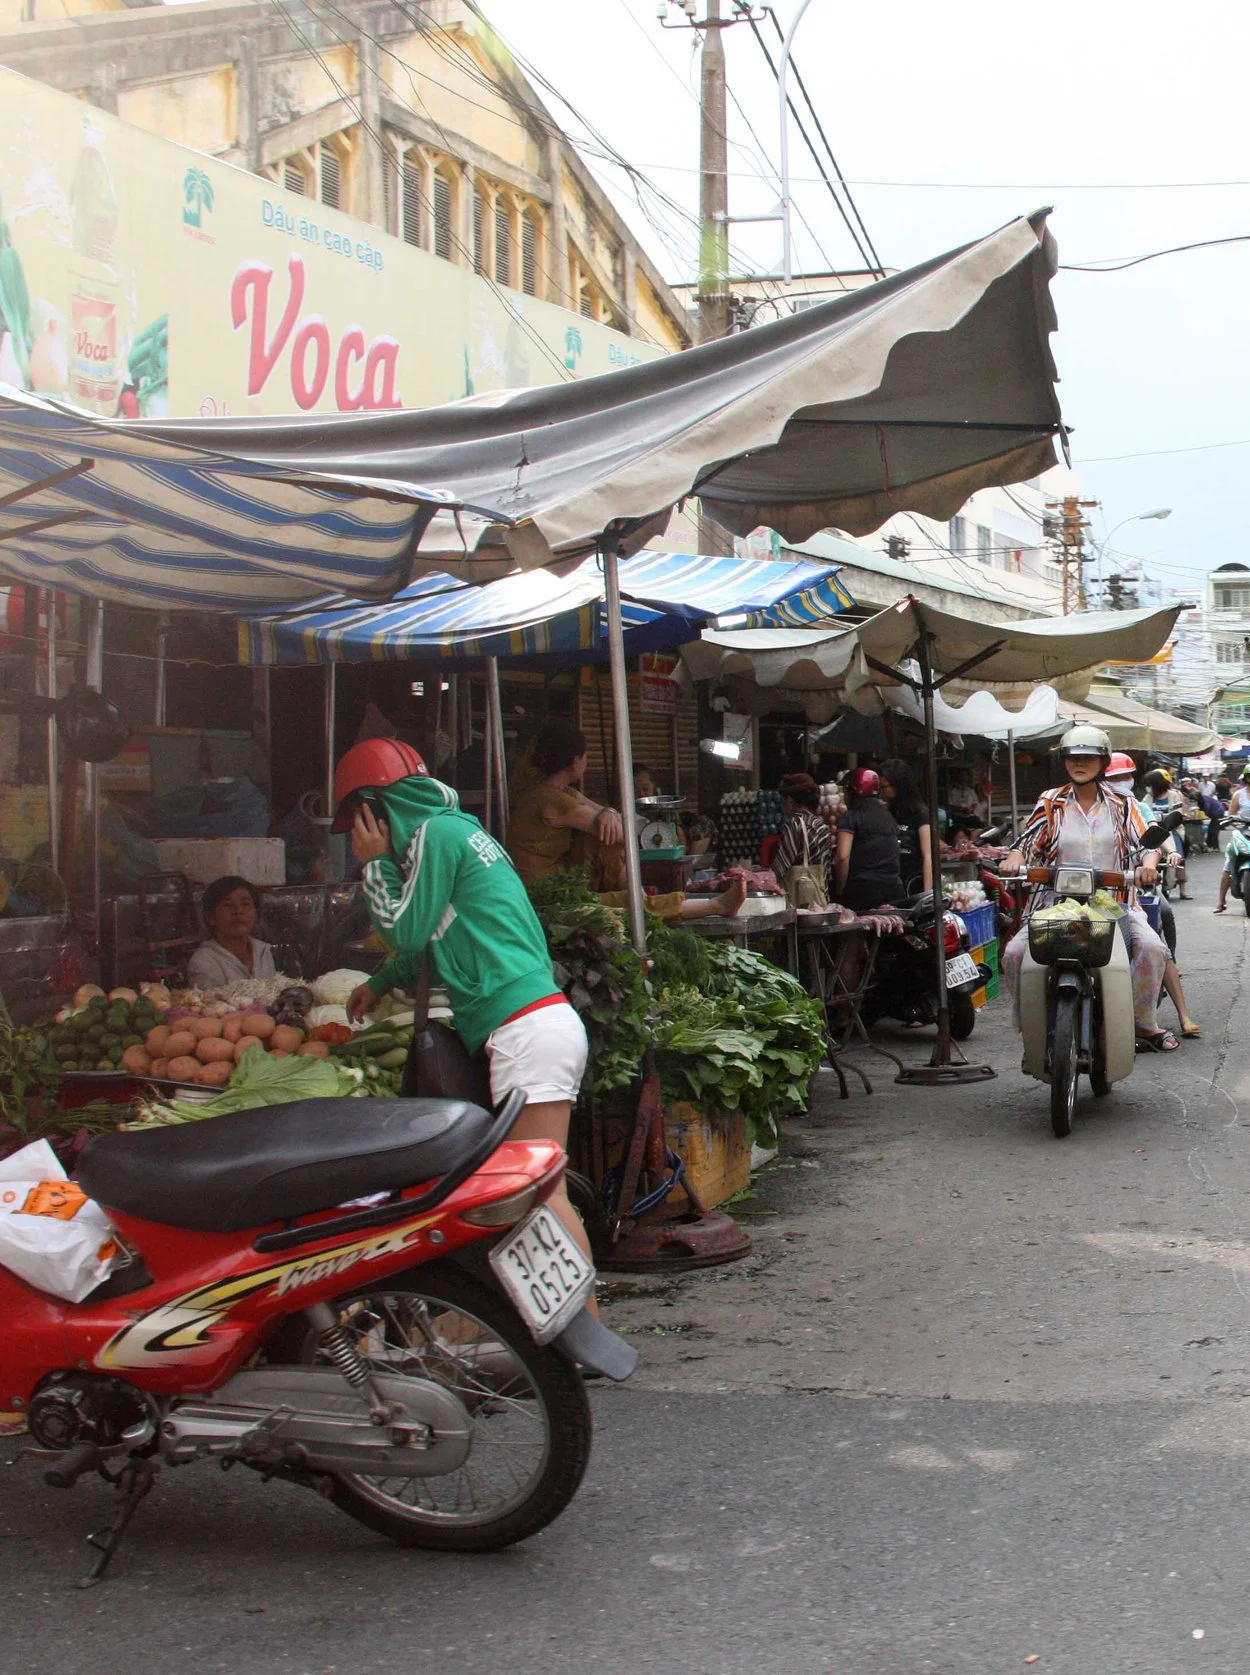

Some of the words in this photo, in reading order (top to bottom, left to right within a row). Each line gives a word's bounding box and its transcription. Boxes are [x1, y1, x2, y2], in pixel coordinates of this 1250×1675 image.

[323, 230, 352, 257] cao
[356, 239, 385, 274] cấp
[75, 332, 109, 362] Voca
[230, 251, 403, 412] Voca
[530, 1247, 581, 1315] 0525
